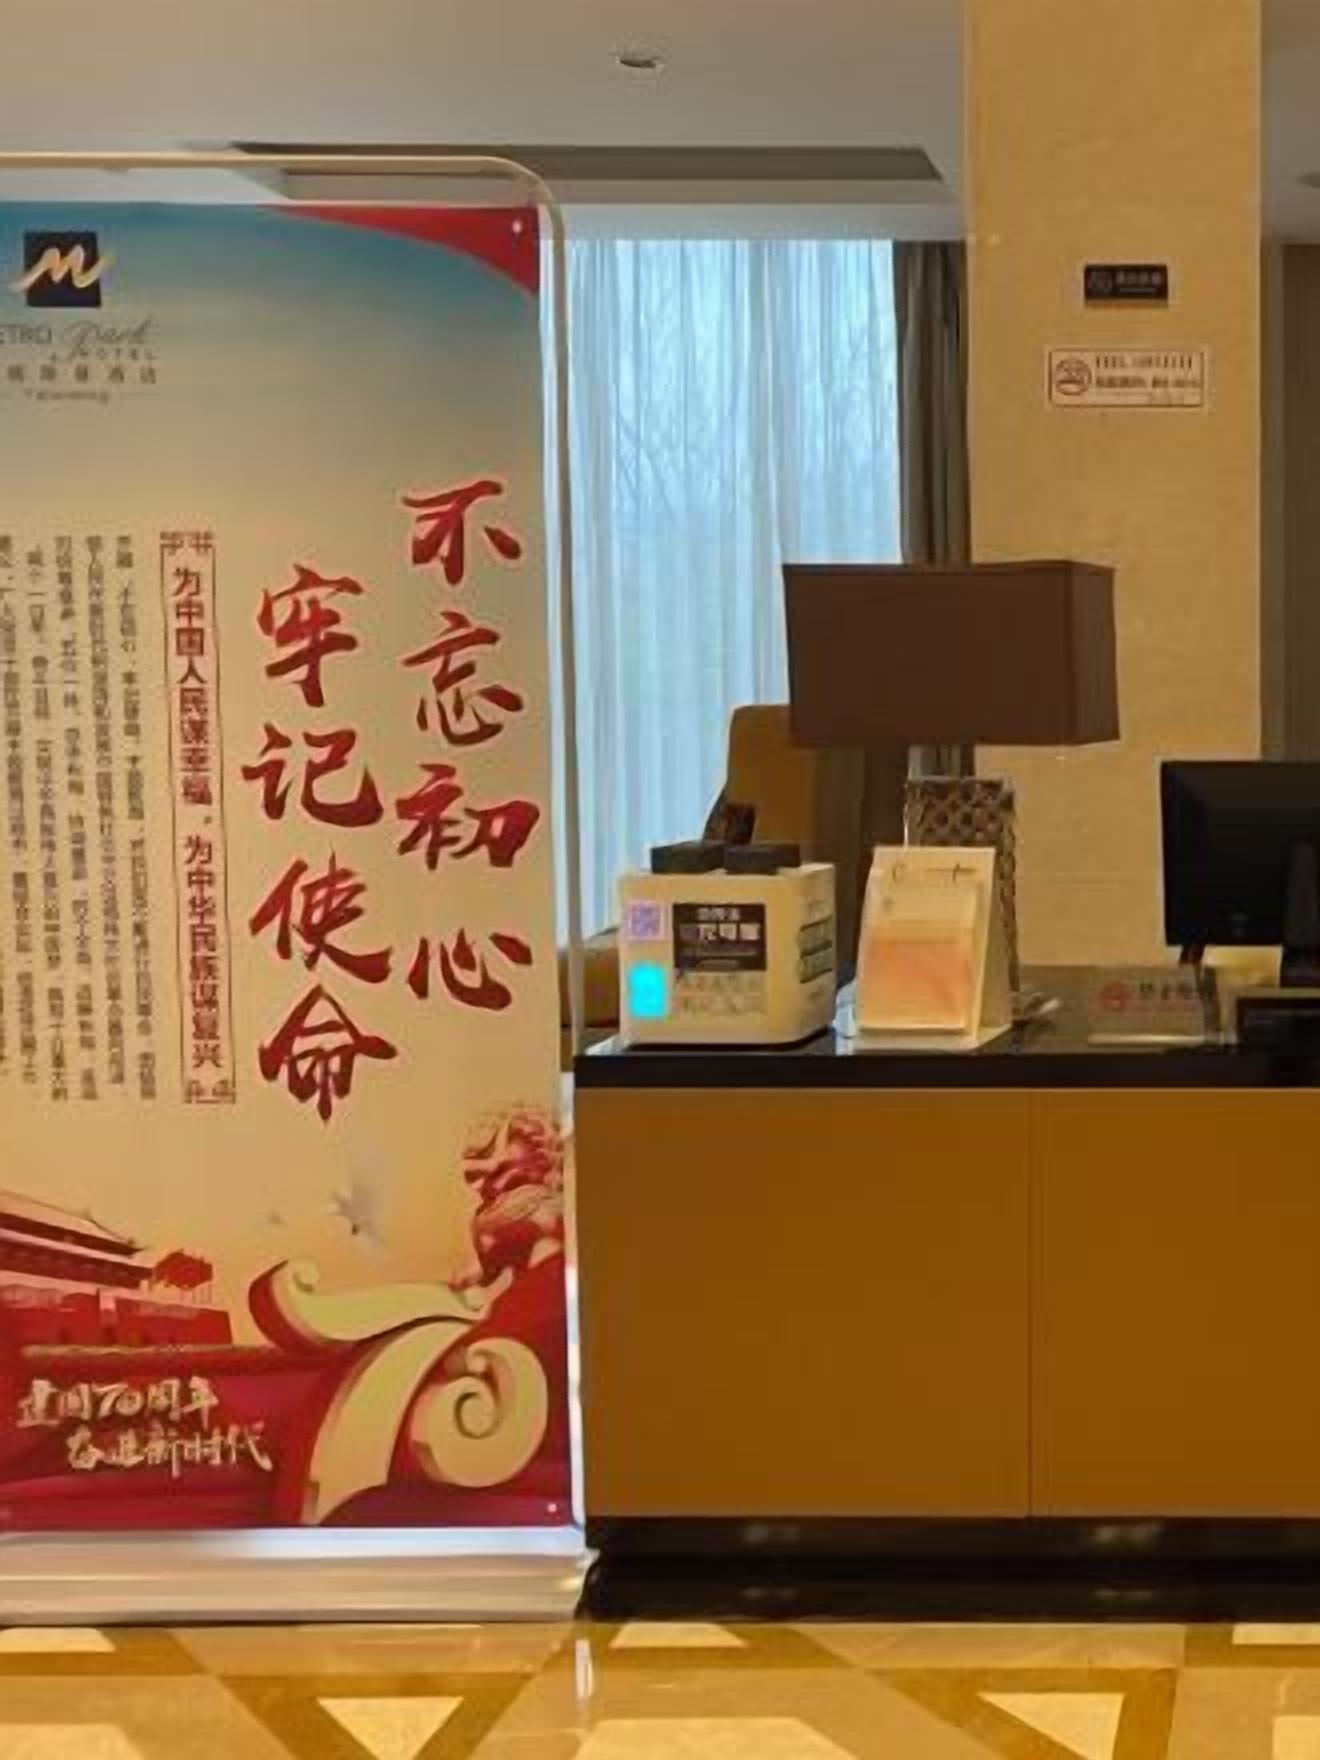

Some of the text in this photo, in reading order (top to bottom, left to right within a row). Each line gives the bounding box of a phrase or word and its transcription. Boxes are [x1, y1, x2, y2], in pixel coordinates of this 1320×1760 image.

[240, 564, 399, 1122] 牢记使命
[397, 480, 540, 1011] 不忘初心
